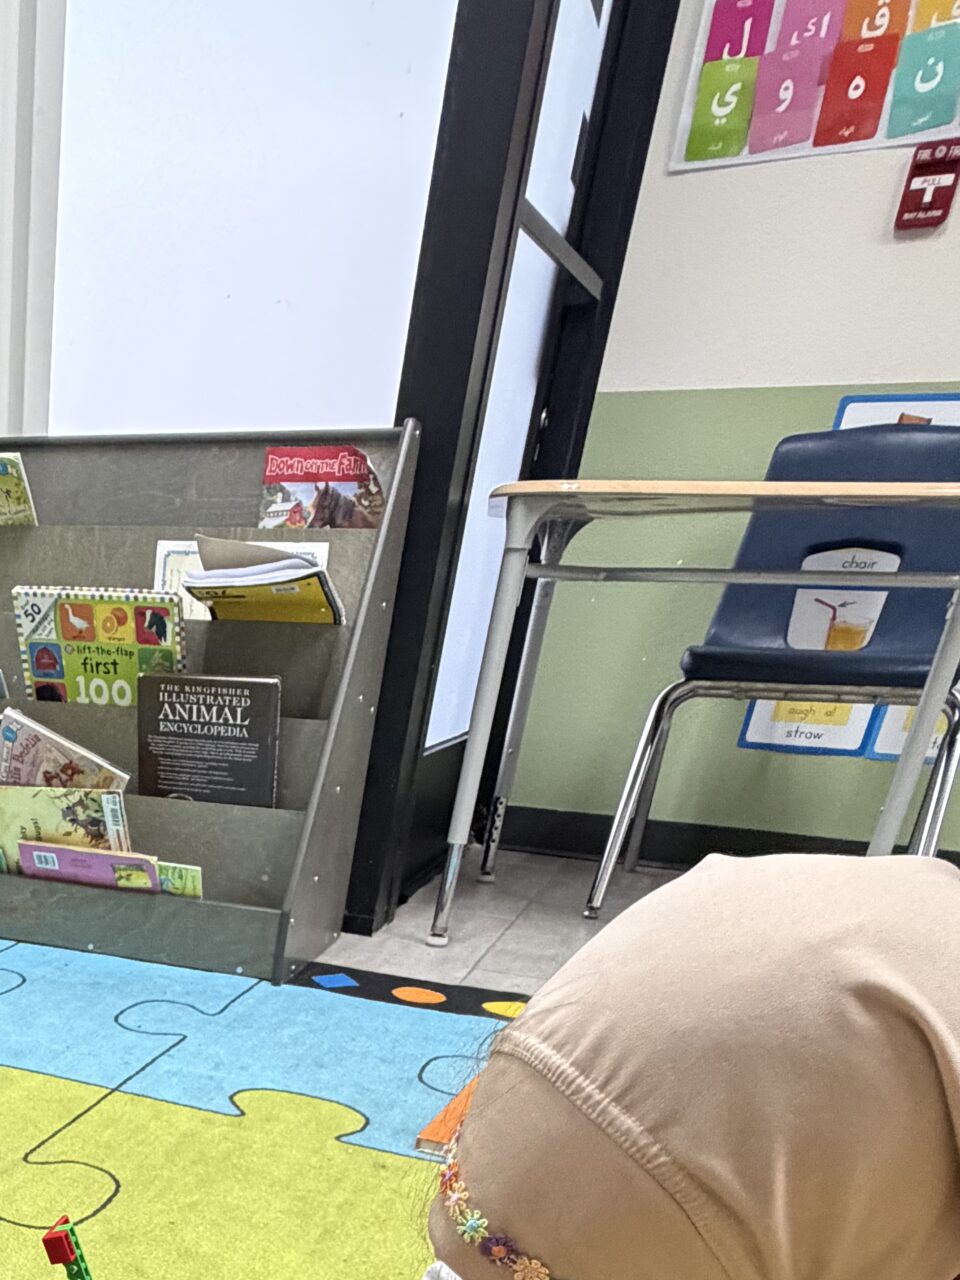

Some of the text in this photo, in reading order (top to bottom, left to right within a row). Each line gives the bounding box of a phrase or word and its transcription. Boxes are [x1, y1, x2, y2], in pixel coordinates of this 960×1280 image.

[914, 57, 944, 93] ن
[711, 82, 743, 126] ي
[775, 79, 794, 113] و
[842, 554, 878, 570] chair
[23, 603, 42, 624] 50
[76, 645, 135, 659] lift-the-flap
[81, 656, 119, 675] first
[75, 675, 133, 707] 100
[159, 692, 251, 707] ILLUSTRATED
[160, 684, 250, 696] THE KINGFISHER
[158, 702, 250, 725] ANIMAL
[159, 721, 249, 738] ENCYCLOPEDIA
[785, 725, 824, 740] straw
